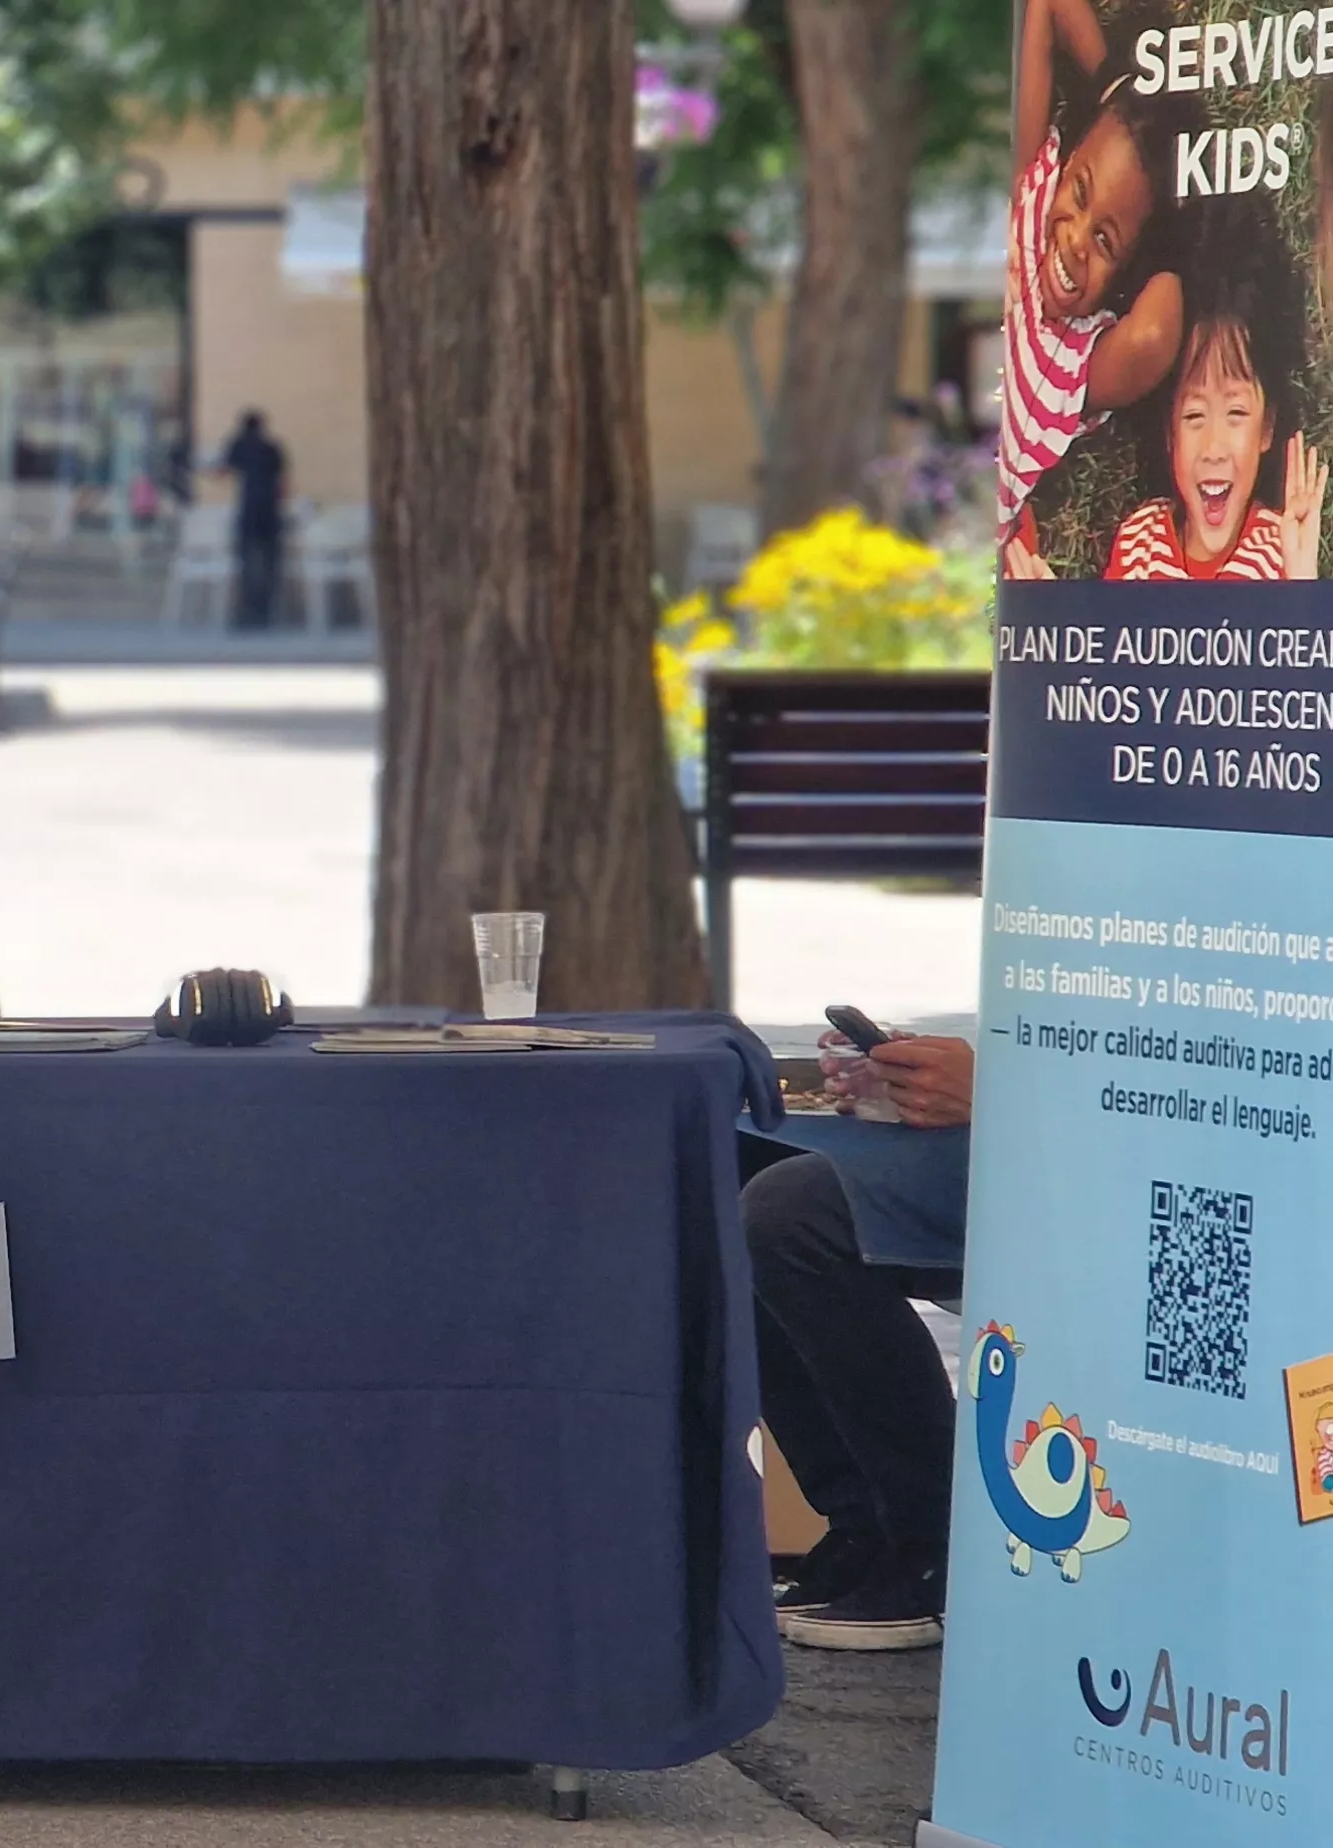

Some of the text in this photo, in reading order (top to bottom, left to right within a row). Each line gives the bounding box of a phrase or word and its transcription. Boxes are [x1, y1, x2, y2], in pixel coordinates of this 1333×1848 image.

[999, 619, 1333, 668] PLAN DE AUDICIÓN CREA
[1045, 677, 1141, 724] NIÑOS
[1146, 686, 1170, 724] Y
[1112, 743, 1322, 792] DE 0 A 16 AÑOS
[993, 902, 1095, 941] Diseñamos
[1100, 911, 1169, 947] planes
[1173, 916, 1198, 949] de
[1201, 920, 1280, 957] audición
[1285, 932, 1321, 965] que
[1004, 964, 1015, 990] a
[1018, 959, 1046, 993] las
[1050, 962, 1132, 1000] familias
[1137, 976, 1152, 1008] y
[1155, 979, 1168, 1004] a
[1173, 973, 1201, 1008] los
[1204, 977, 1259, 1019] niños,
[1016, 1014, 1032, 1047] la
[1037, 1021, 1099, 1057] mejor
[1104, 1026, 1178, 1063] calidad
[1183, 1034, 1256, 1072] auditiva
[1260, 1046, 1303, 1079] para
[1100, 1080, 1317, 1142] desarrollar el lenguaje.
[1176, 1434, 1186, 1455] el
[1188, 1441, 1245, 1468] audiolibro
[1139, 1647, 1289, 1778] Aural
[1074, 1735, 1288, 1817] CENTROS AUDITIVOS
